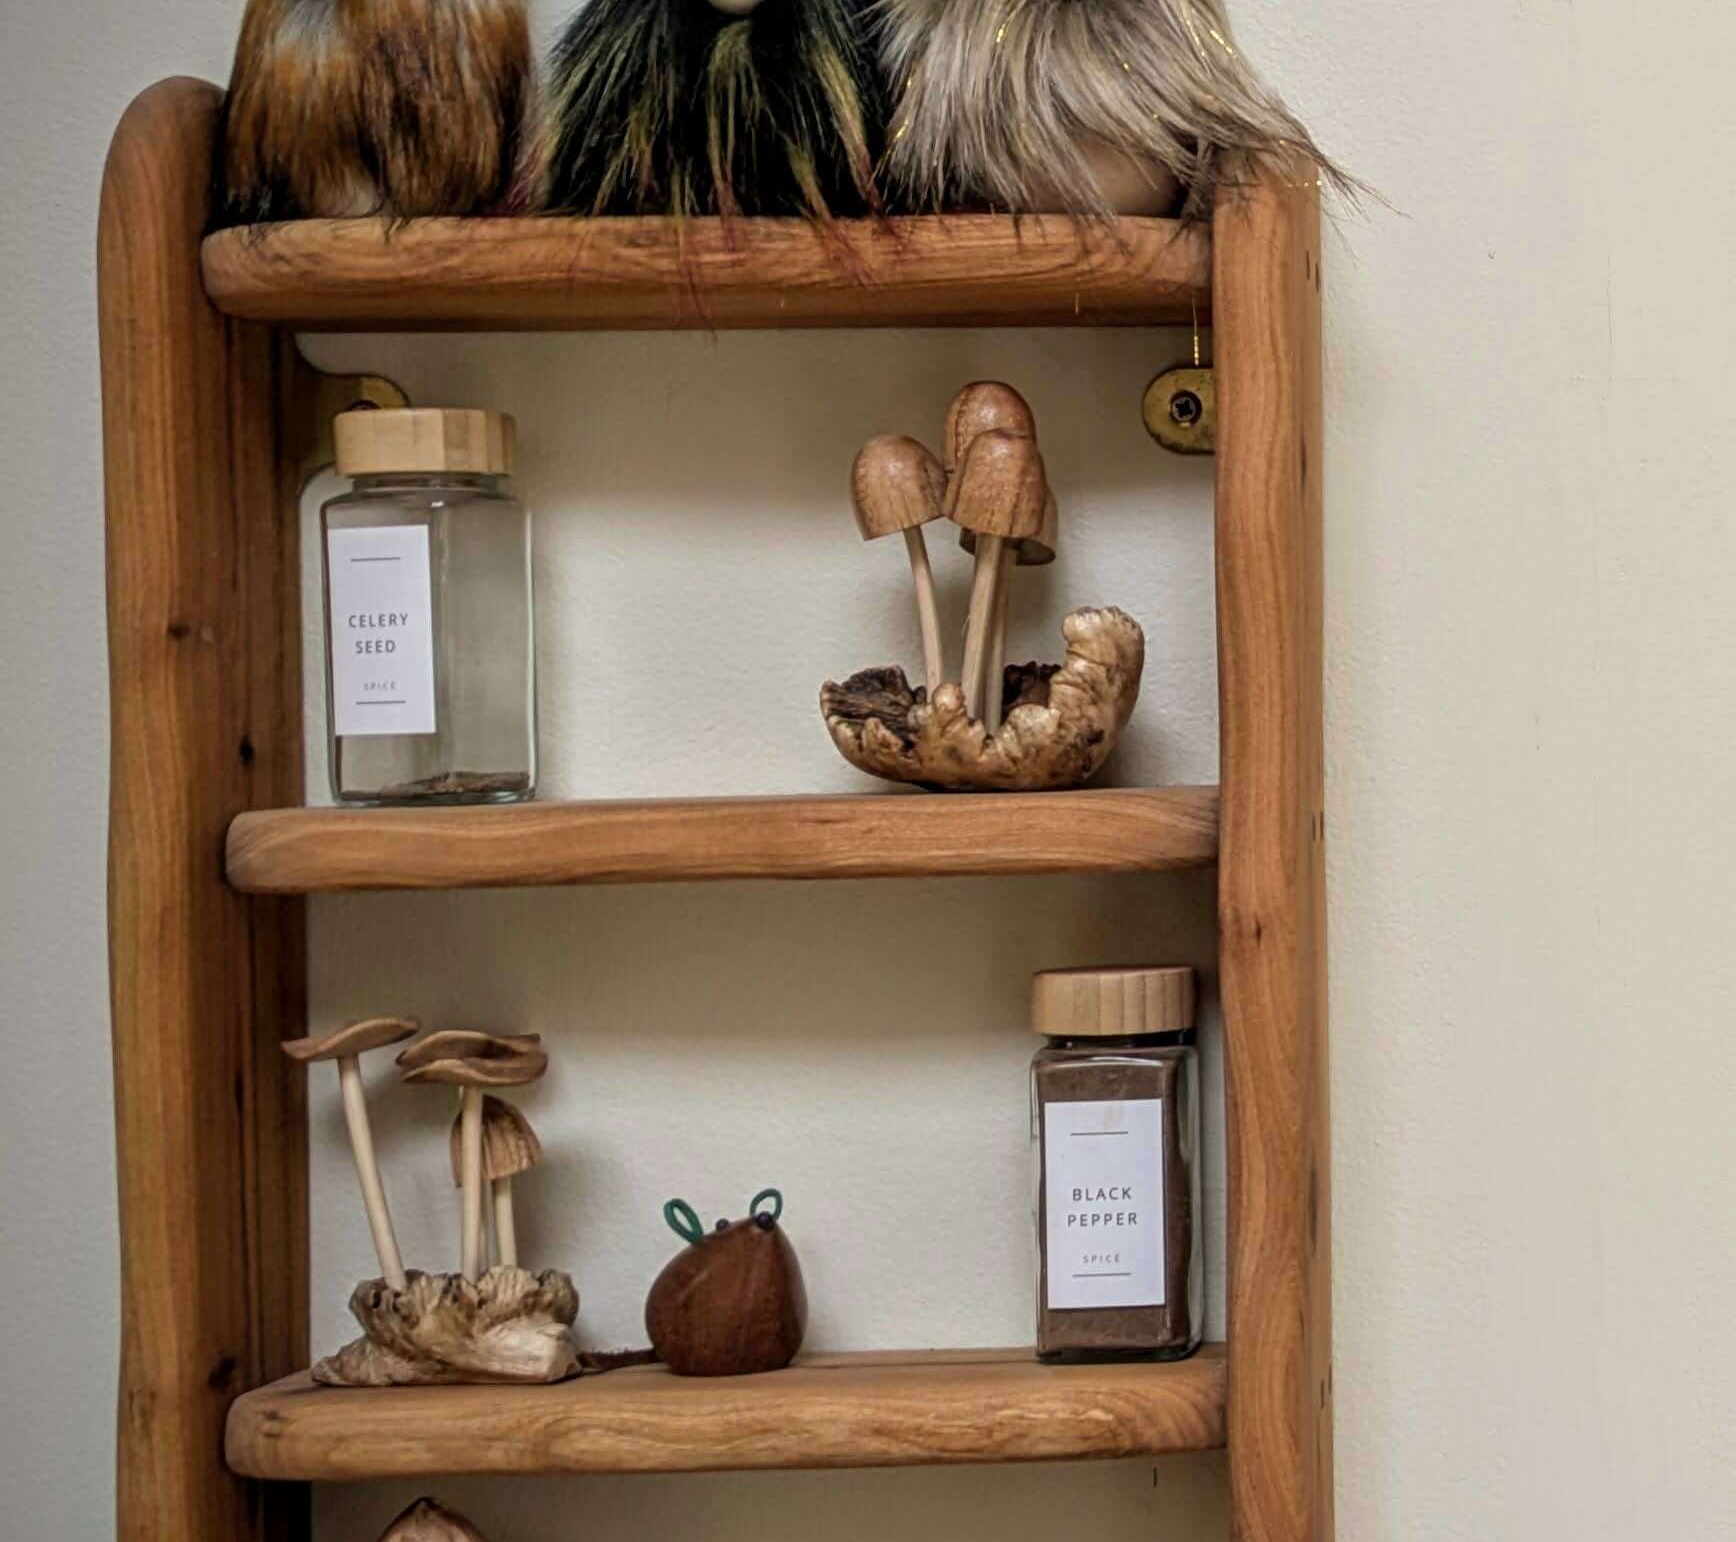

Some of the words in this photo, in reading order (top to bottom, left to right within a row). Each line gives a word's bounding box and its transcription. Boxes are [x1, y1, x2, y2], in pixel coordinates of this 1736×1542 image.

[348, 613, 408, 628] CELERY
[355, 639, 397, 654] SEED
[364, 682, 396, 691] SPICE
[1072, 1187, 1132, 1201] BLACK
[1067, 1212, 1138, 1227] PEPPER
[1083, 1254, 1121, 1263] SPICE
